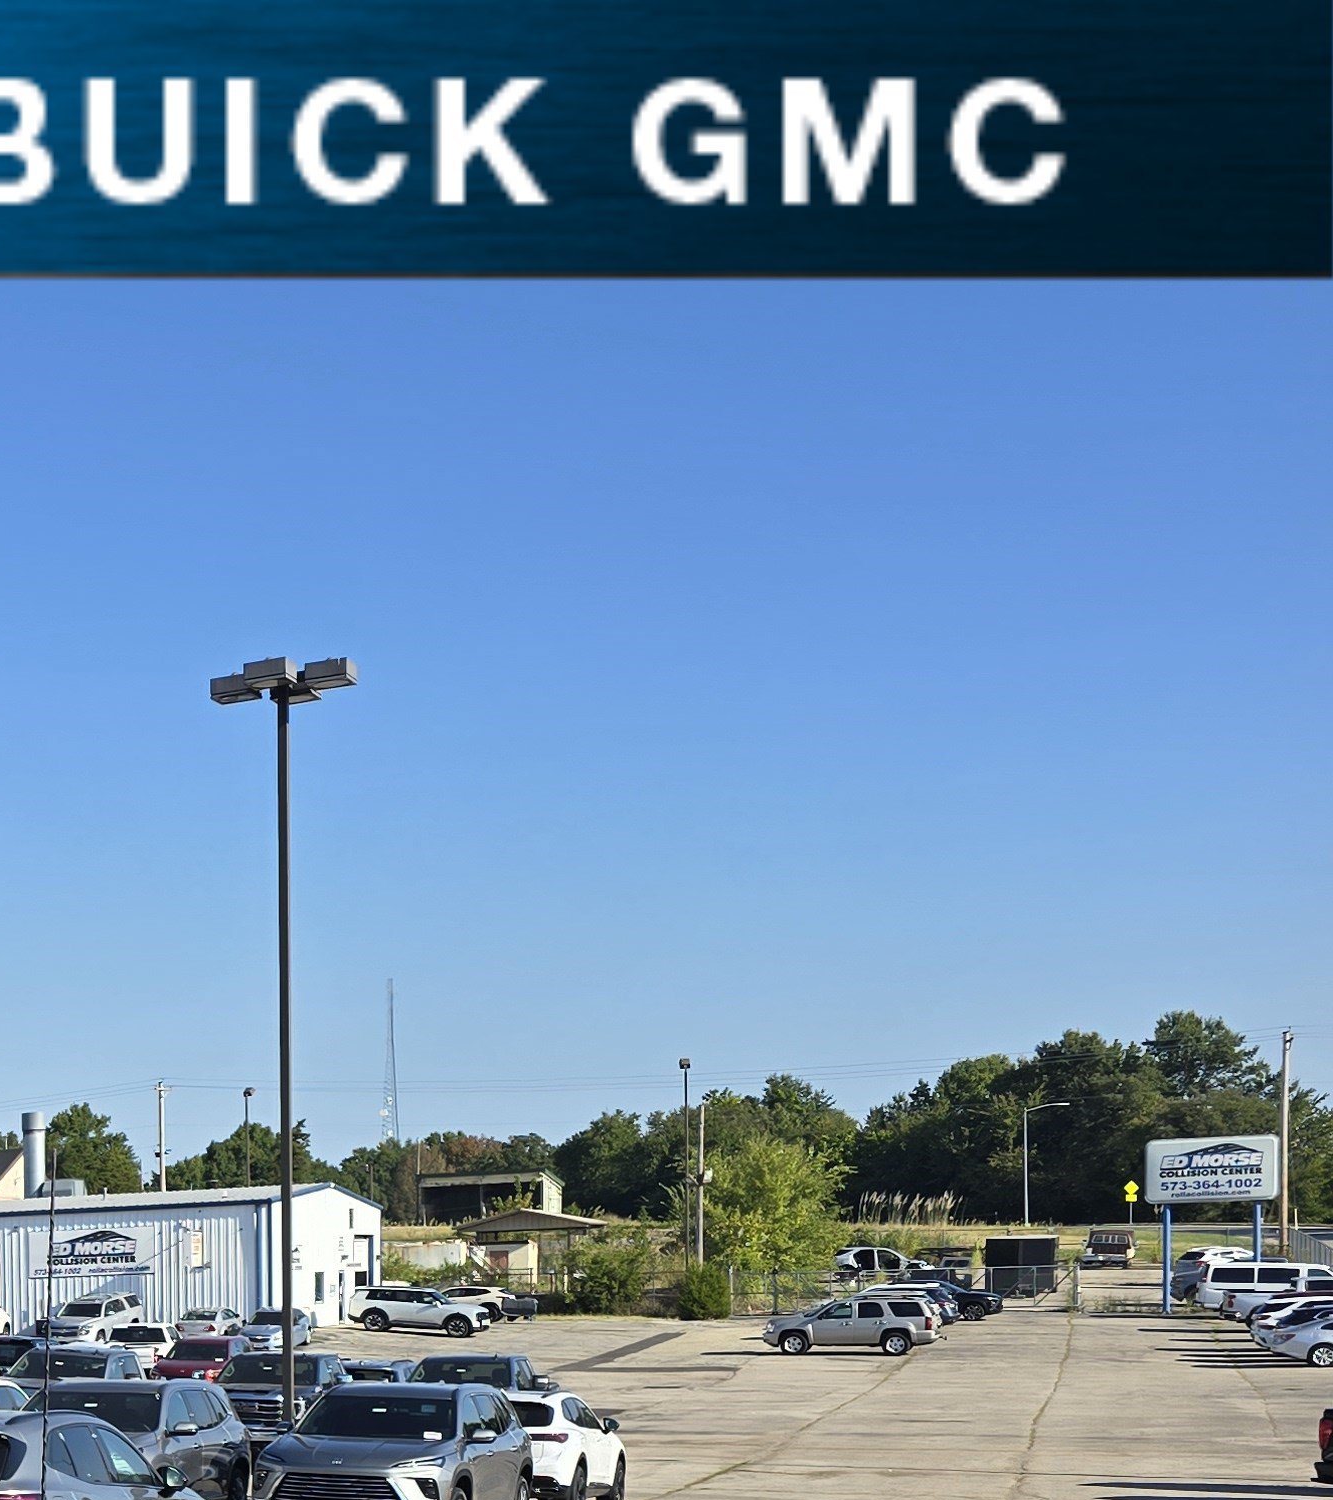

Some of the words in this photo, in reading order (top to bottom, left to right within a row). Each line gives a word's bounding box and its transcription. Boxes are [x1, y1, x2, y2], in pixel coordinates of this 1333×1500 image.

[1160, 1155, 1189, 1170] ED
[1190, 1151, 1263, 1168] MORSE
[1159, 1169, 1218, 1178] COLLISION
[1220, 1167, 1263, 1176] CENTER
[1160, 1178, 1263, 1192] 573-364-1002
[1170, 1189, 1251, 1198] rollacollision.com
[73, 1239, 136, 1256] MORSE
[47, 1256, 98, 1266] OLLISION
[100, 1255, 137, 1264] CENTER
